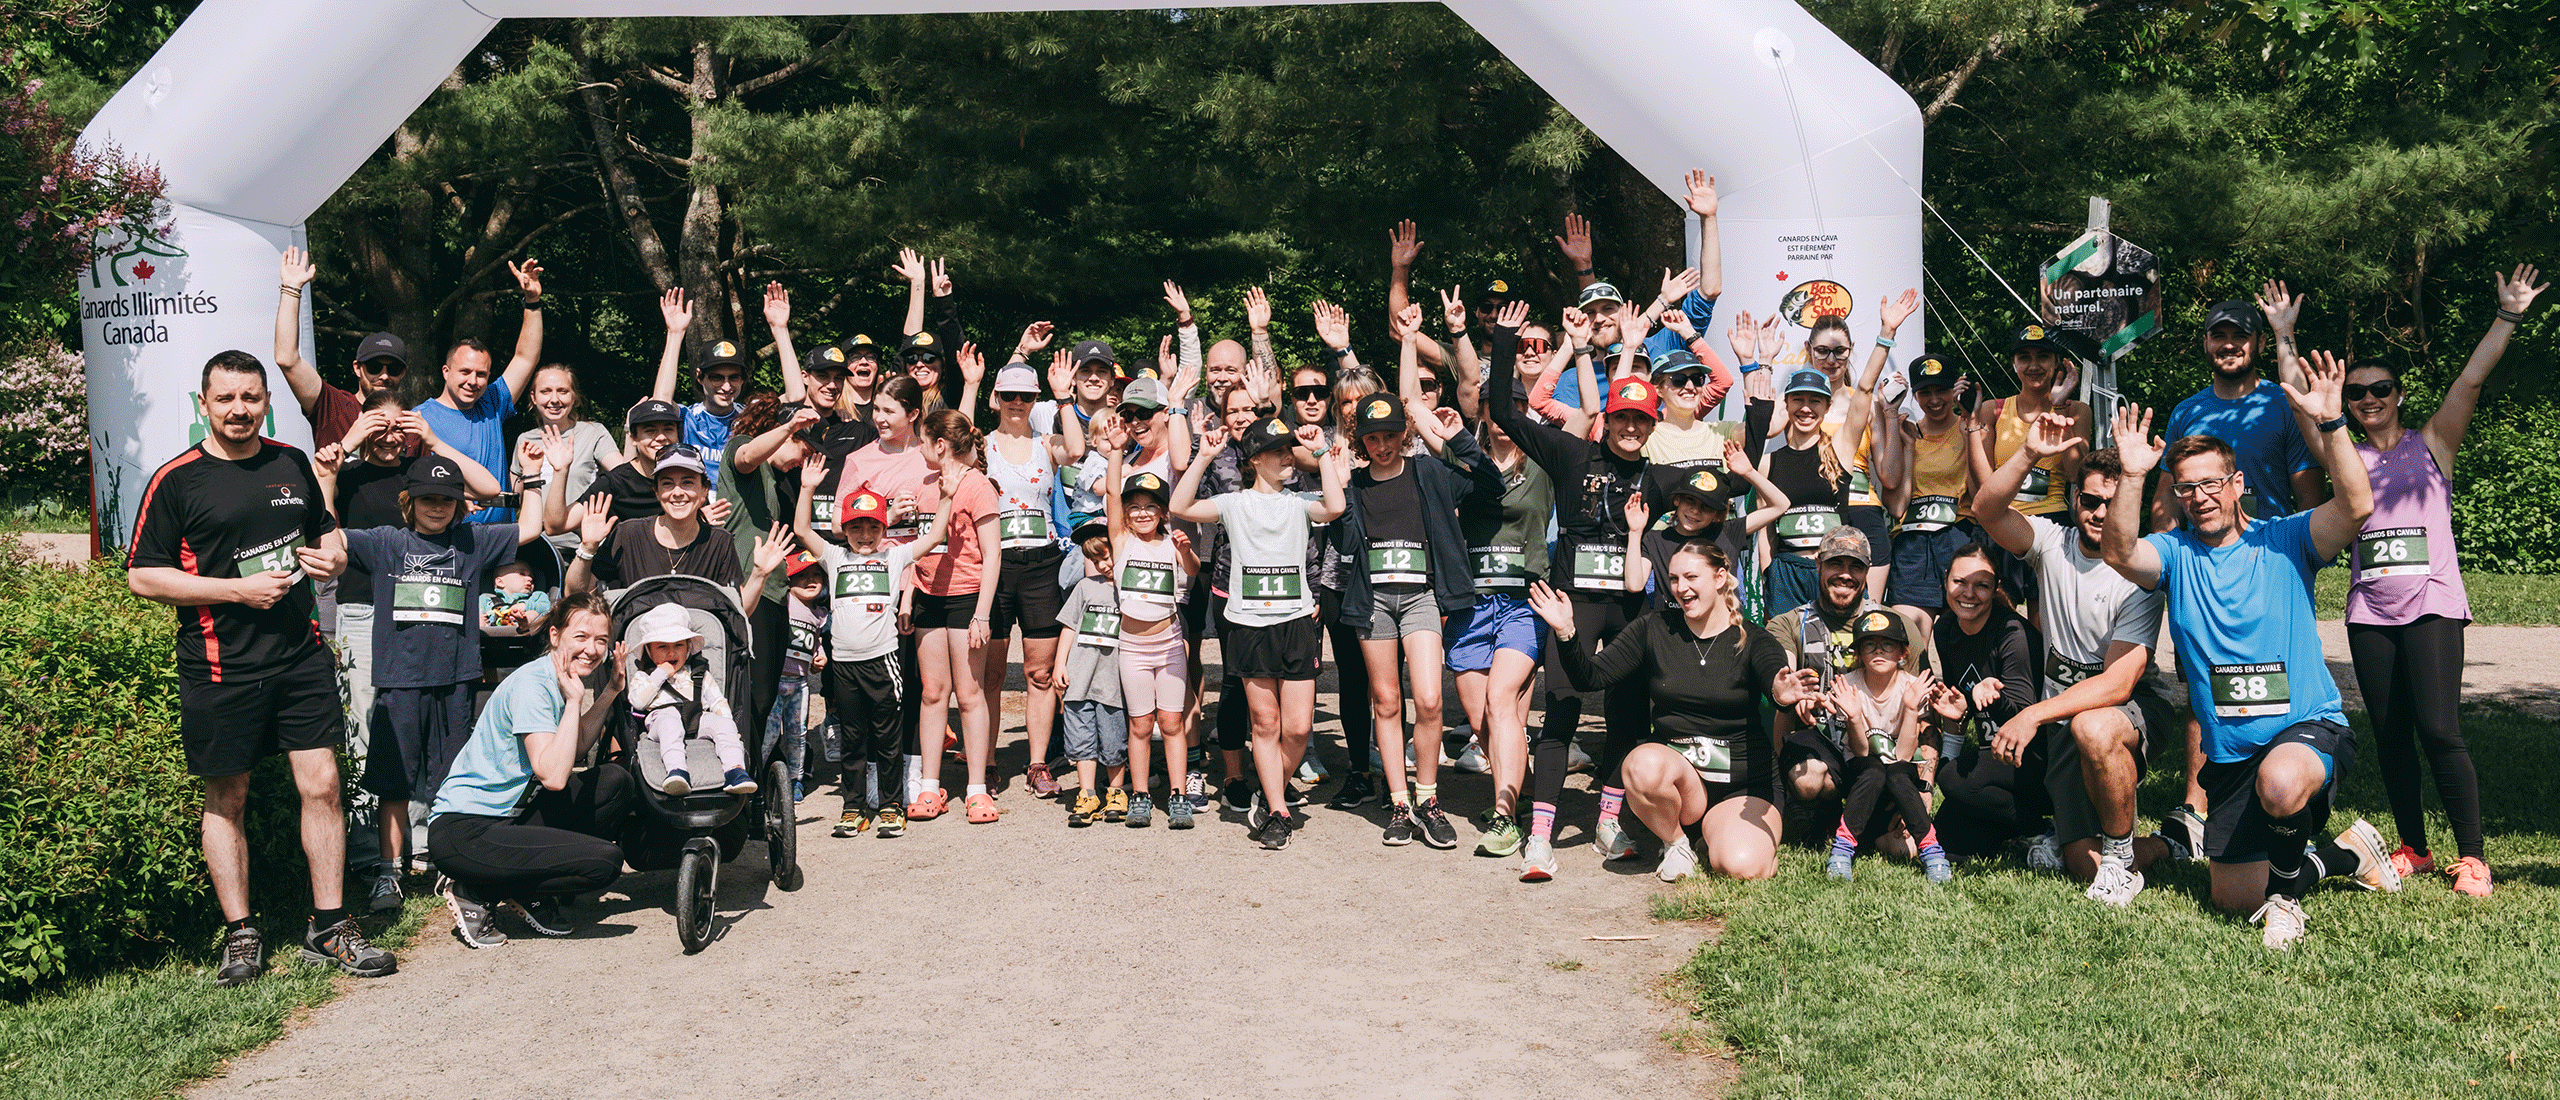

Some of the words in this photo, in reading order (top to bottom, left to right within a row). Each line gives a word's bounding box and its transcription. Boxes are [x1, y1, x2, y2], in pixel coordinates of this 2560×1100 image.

[1787, 244, 1798, 252] EST
[1800, 243, 1836, 251] FIÈREMENT
[1787, 253, 1819, 261] PARRAINÉ
[1810, 282, 1838, 295] Bass
[2053, 288, 2071, 300] Un
[2074, 284, 2143, 301] partenaire
[81, 293, 130, 320] Canards
[132, 290, 218, 317] Illimités
[1811, 294, 1833, 307] Pro
[2054, 300, 2105, 314] naturel.
[1811, 305, 1847, 319] Shops
[103, 319, 169, 345] Canada
[270, 496, 305, 507] monette
[1915, 502, 1941, 520] 30
[1007, 517, 1033, 535] 41
[1794, 514, 1825, 533] 43
[240, 541, 273, 559] CANARDS
[273, 538, 283, 547] EN
[283, 528, 300, 543] CAVALE
[2361, 531, 2386, 541] CANARDS
[2396, 528, 2422, 536] CAVALE
[1371, 541, 1395, 549] CANARDS
[1403, 541, 1422, 549] CAVALE
[1469, 546, 1491, 554] CANARDS
[1491, 545, 1500, 553] EN
[1500, 545, 1521, 553] CAVALE
[1608, 545, 1617, 553] EN
[2373, 539, 2408, 563] 26
[261, 545, 296, 572] 54
[1382, 549, 1412, 569] 12
[1479, 554, 1509, 574] 13
[1593, 553, 1624, 576] 18
[1271, 566, 1280, 574] EN
[1280, 566, 1297, 574] CAVALE
[401, 575, 431, 583] CANARDS
[442, 577, 463, 586] CAVALE
[845, 573, 875, 592] 23
[1136, 570, 1166, 590] 27
[1258, 576, 1288, 596] 11
[423, 585, 441, 607] 6
[1092, 614, 1120, 634] 17
[790, 629, 814, 650] 20
[2058, 664, 2087, 684] 24
[2070, 660, 2079, 668] EN
[2079, 663, 2103, 671] CAVALE
[2244, 665, 2255, 673] EN
[2255, 663, 2282, 672] CAVALE
[2229, 676, 2268, 700] 38
[1681, 745, 1711, 767] 49
